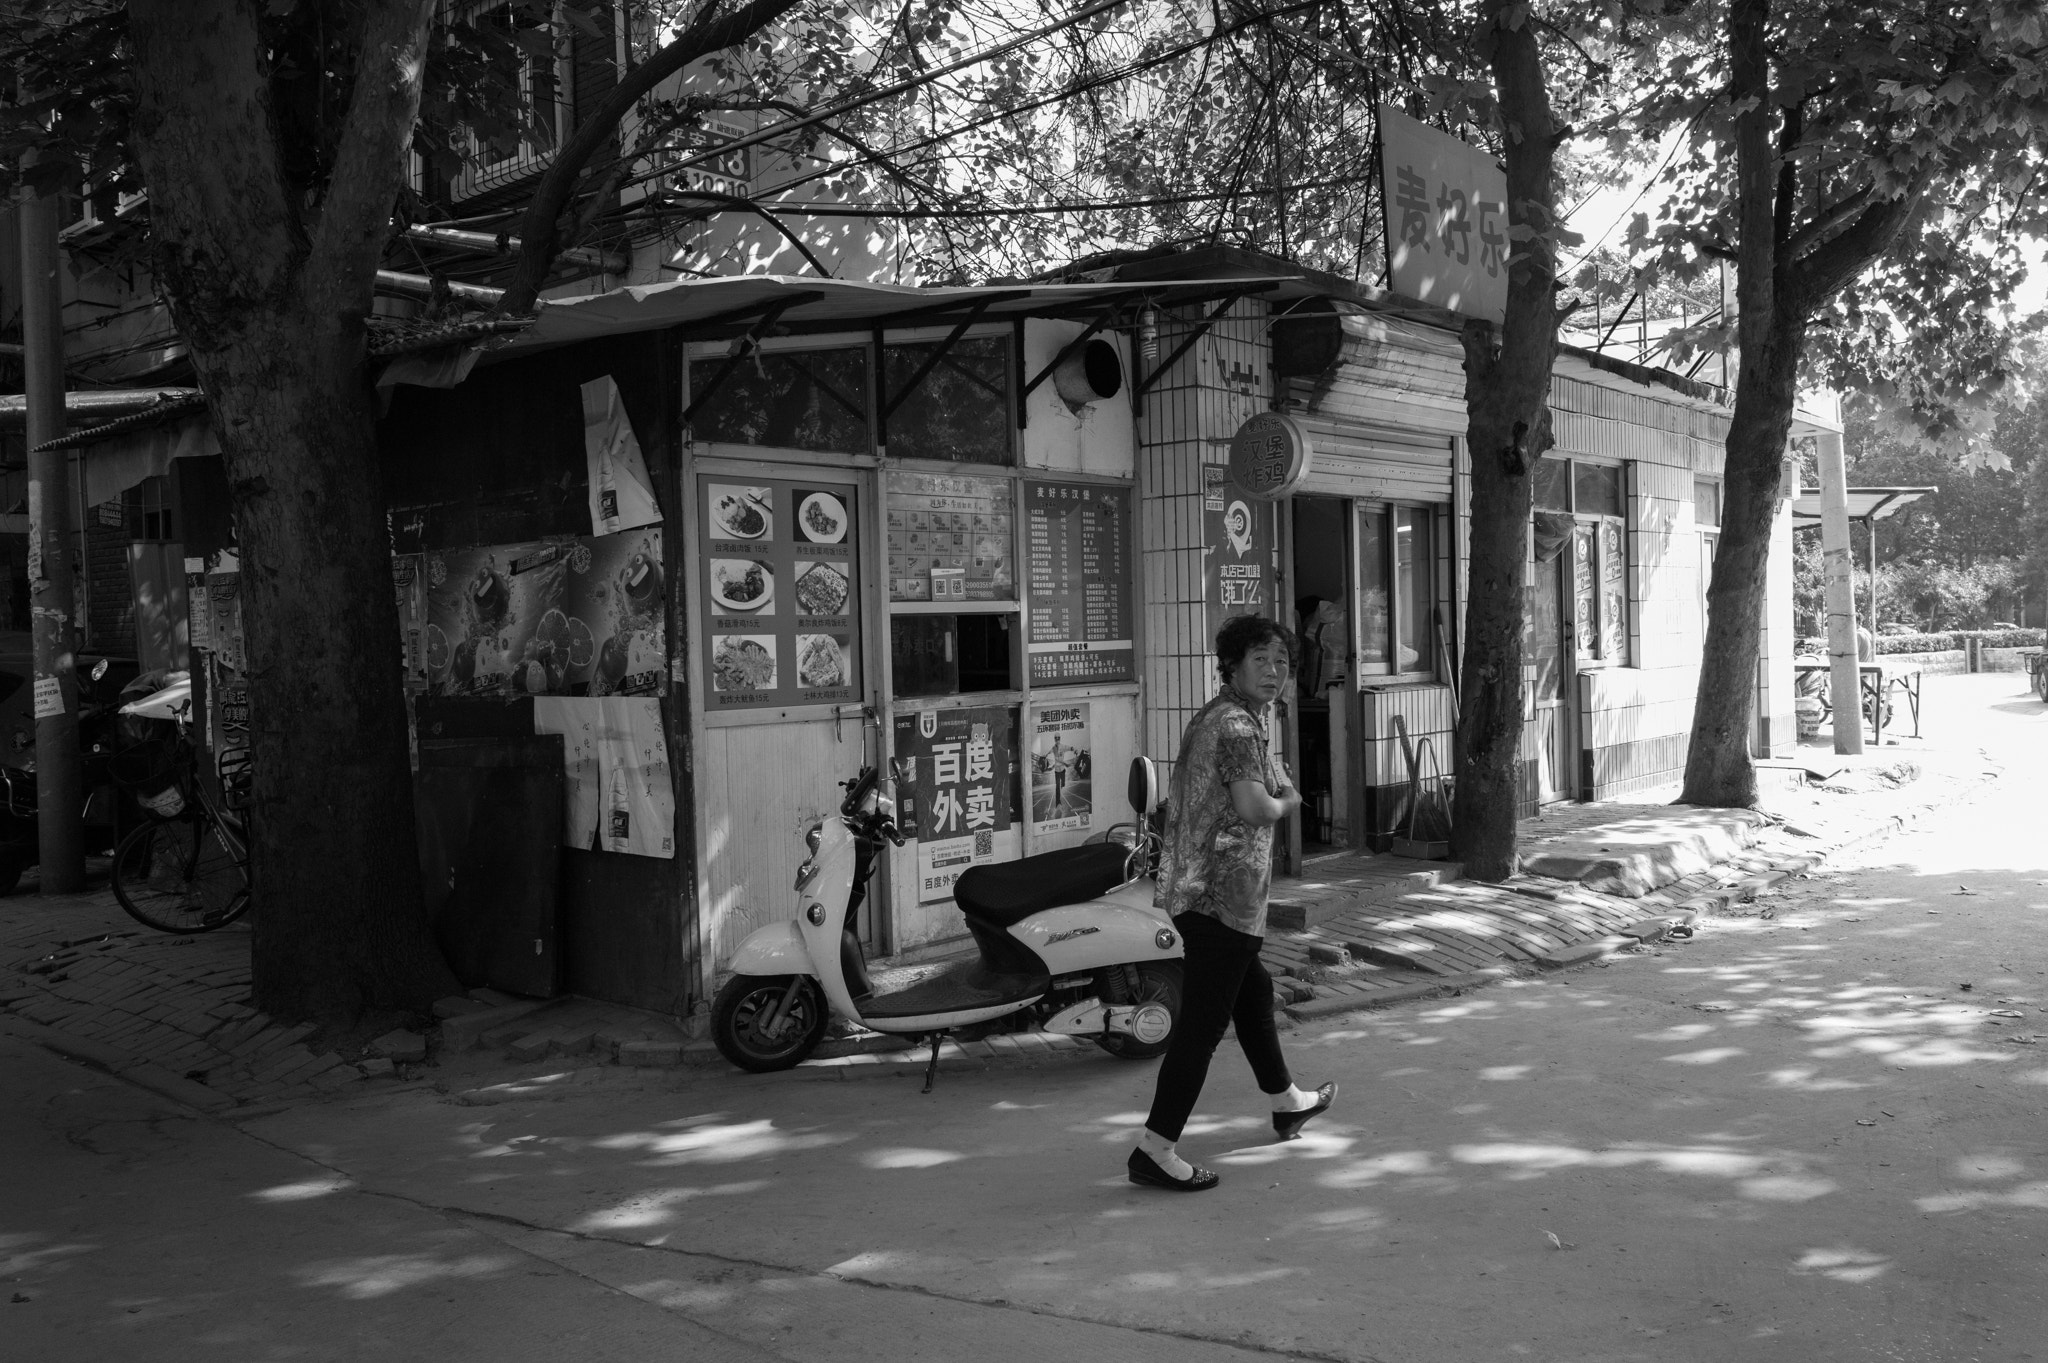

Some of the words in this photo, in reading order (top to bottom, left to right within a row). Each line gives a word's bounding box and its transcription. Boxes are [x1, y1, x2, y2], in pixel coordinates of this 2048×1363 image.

[1395, 164, 1508, 279] 麦好乐
[1246, 417, 1281, 434] 麦好乐
[1243, 435, 1285, 464] 汉堡
[1243, 461, 1285, 489] 炸鸡
[1036, 487, 1090, 500] 麦好乐汉堡
[714, 544, 751, 553] 台湾卤肉饭
[754, 545, 768, 554] 15元
[1220, 564, 1261, 578] 本店已加盟
[1220, 580, 1261, 605] 饿了么
[1041, 708, 1080, 723] 美团外卖
[932, 740, 994, 786] 百度
[932, 785, 995, 833] 外卖
[925, 873, 959, 890] 百度外卖
